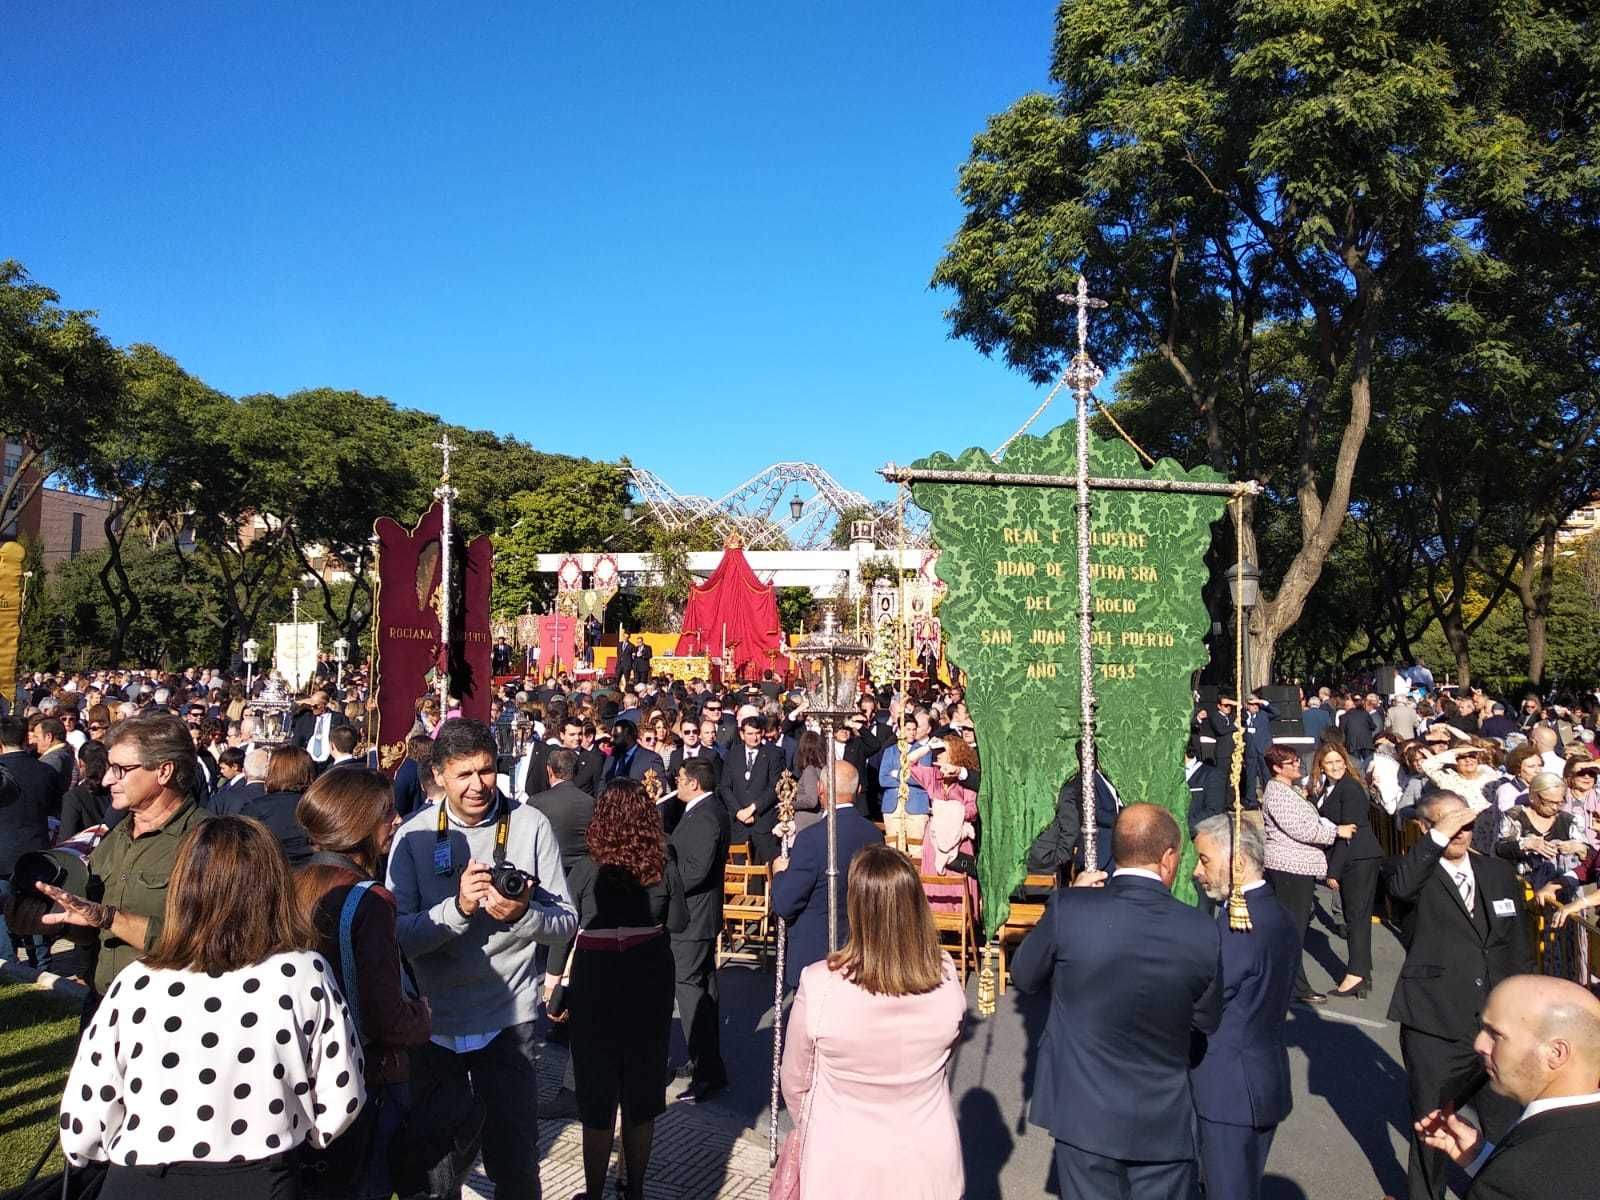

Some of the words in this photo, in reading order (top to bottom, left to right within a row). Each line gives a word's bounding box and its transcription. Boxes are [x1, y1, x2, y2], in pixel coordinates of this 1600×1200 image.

[1003, 527, 1041, 544] REAL
[1052, 528, 1061, 544] E
[1089, 531, 1148, 549] ILUSTRE
[997, 561, 1036, 577] HDAD
[1046, 563, 1064, 578] DE
[1088, 564, 1126, 581] NTRA
[1132, 566, 1158, 582] SRA
[1026, 596, 1053, 611] DEL
[1096, 598, 1137, 613] ROCIO
[389, 627, 433, 640] ROCIANA
[981, 630, 1012, 645] SAN
[1029, 630, 1066, 645] JUAN
[1090, 631, 1114, 645] DEL
[1121, 632, 1175, 647] PUERTO
